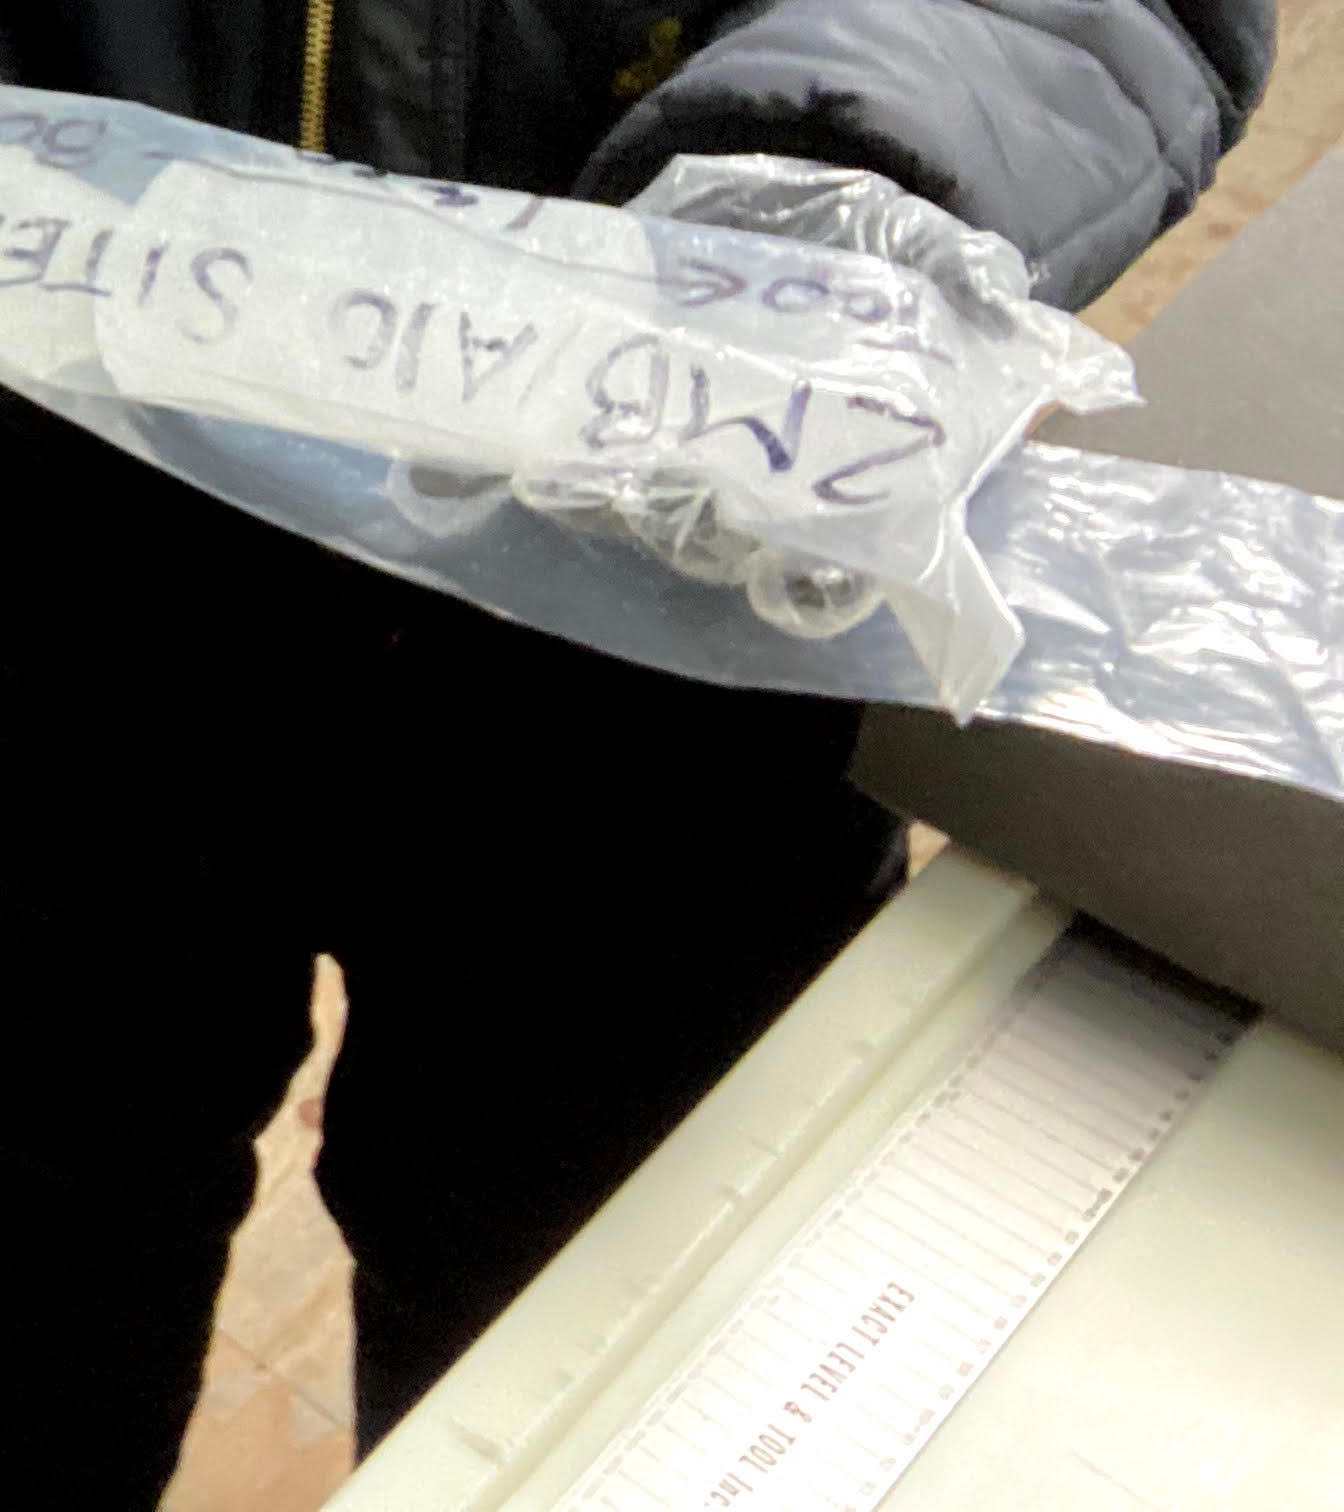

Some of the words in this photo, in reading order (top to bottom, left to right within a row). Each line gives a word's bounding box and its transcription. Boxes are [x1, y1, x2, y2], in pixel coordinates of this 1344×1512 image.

[850, 1281, 916, 1347] EXACT
[799, 1341, 866, 1401] LEVEL
[782, 1400, 813, 1423] &
[738, 1423, 796, 1474] TOOL
